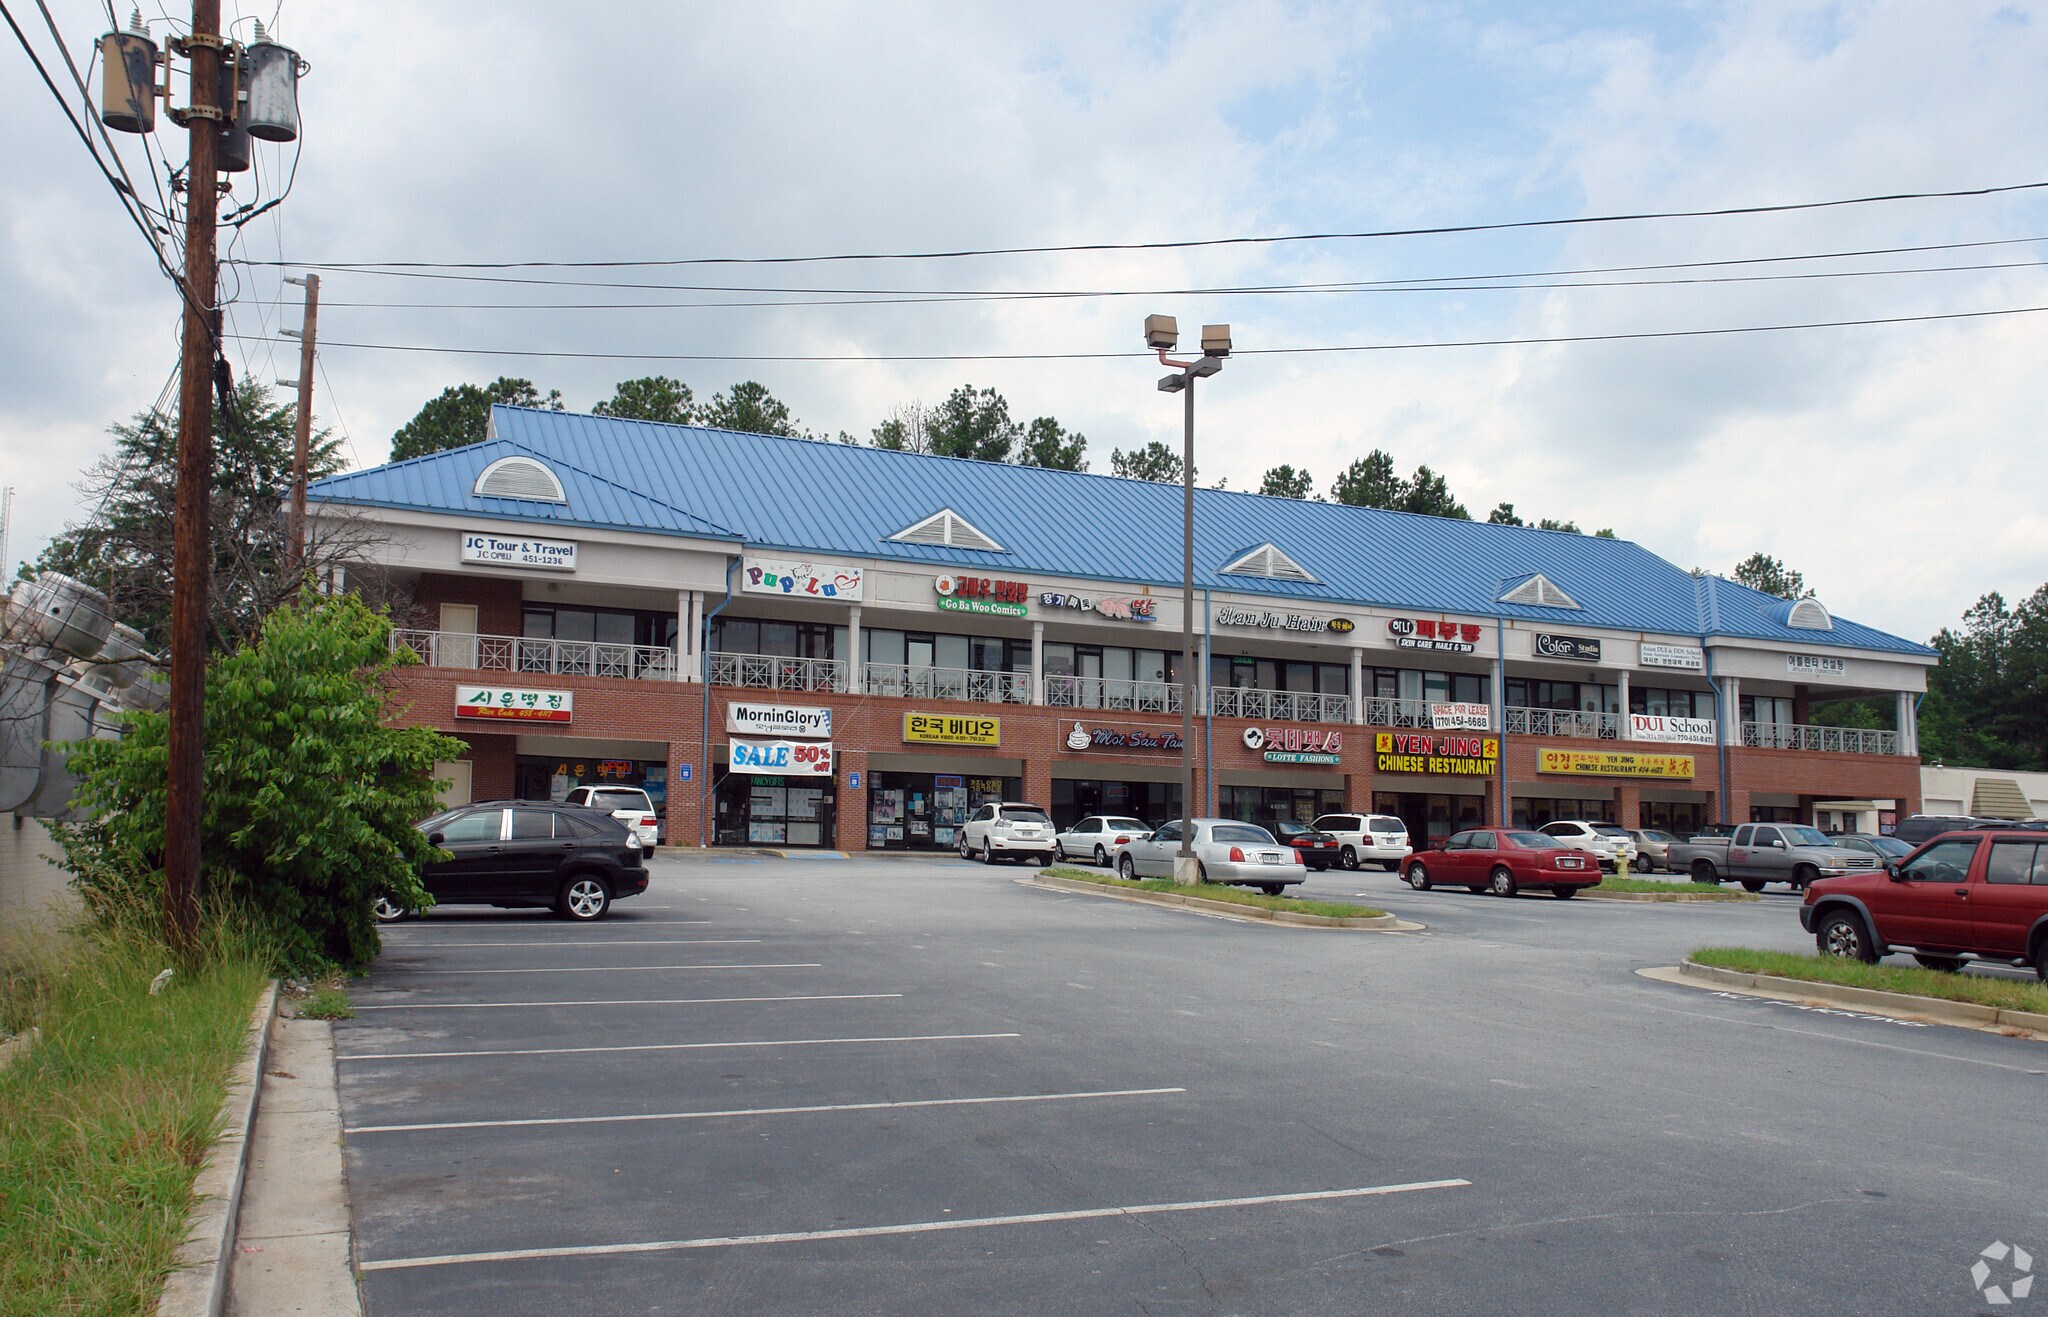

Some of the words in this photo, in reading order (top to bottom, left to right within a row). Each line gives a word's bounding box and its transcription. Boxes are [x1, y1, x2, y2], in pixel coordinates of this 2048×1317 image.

[466, 537, 485, 549] JC
[488, 539, 519, 551] Tour
[521, 542, 531, 552] &
[533, 543, 573, 556] Travel
[477, 551, 489, 559] JC
[522, 555, 563, 565] 451-1236
[945, 599, 958, 609] Go
[959, 600, 970, 610] Ba
[971, 601, 990, 612] Woo
[991, 604, 1021, 615] Comics
[1218, 606, 1257, 625] Han
[1259, 612, 1281, 628] Ju
[1285, 614, 1327, 632] Hair
[1400, 639, 1415, 647] SKIN
[1417, 640, 1433, 649] CARE
[1460, 644, 1472, 652] TAN
[1538, 635, 1574, 655] Color
[1578, 643, 1599, 653] Studio
[476, 707, 495, 716] Rice
[497, 708, 515, 716] Cake
[736, 707, 822, 728] MorninGlory
[1432, 705, 1453, 716] SPACE
[1454, 704, 1466, 714] FOR
[1468, 705, 1488, 716] LEASE
[911, 716, 944, 734] 한국
[949, 719, 995, 737] 비디오
[1633, 716, 1665, 731] DUI
[1669, 717, 1713, 734] School
[1394, 734, 1433, 754] YEN
[1439, 736, 1482, 757] JING
[733, 745, 790, 767] SALE
[793, 745, 831, 763] 50%
[1272, 753, 1297, 761] LOTTE
[1299, 754, 1334, 763] FASHIONS
[1606, 755, 1618, 763] YEN
[1620, 756, 1635, 764] JING
[813, 761, 831, 772] off
[1378, 755, 1424, 773] CHINESE
[1428, 756, 1497, 775] RESTAURANT
[1575, 763, 1598, 772] CHINESE
[1600, 764, 1637, 773] RESTAURANT
[751, 776, 769, 786] FANCY
